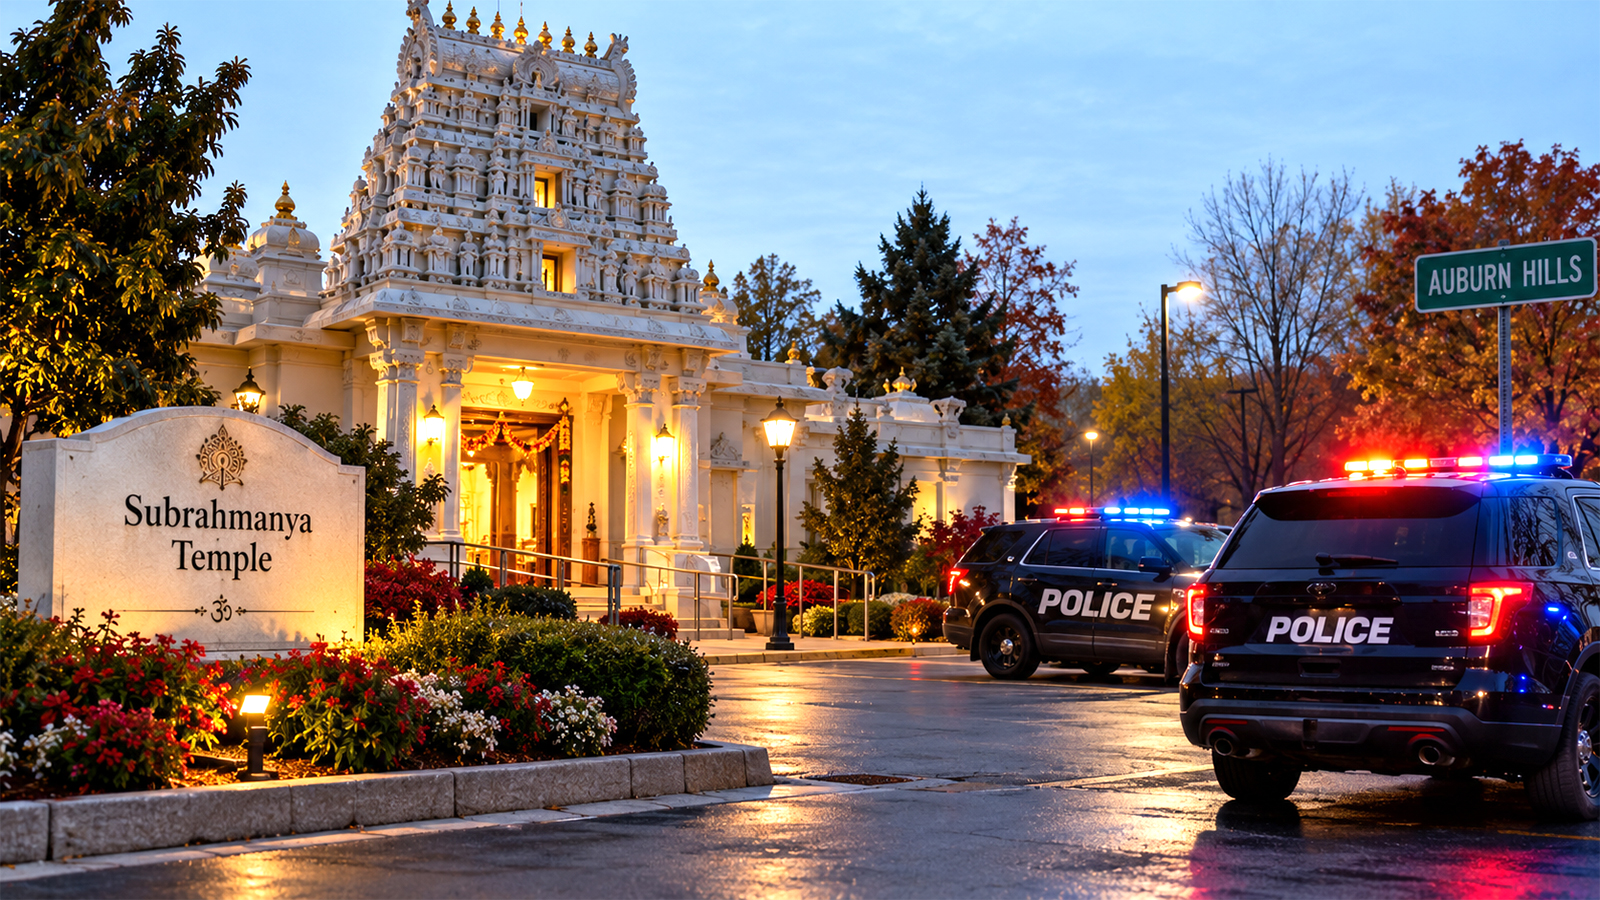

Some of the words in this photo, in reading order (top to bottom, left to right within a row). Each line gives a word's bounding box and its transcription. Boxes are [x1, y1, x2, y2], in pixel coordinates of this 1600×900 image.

[1428, 262, 1511, 296] AUBURN
[1523, 254, 1582, 287] HILLS
[124, 493, 313, 541] Subrahmanya
[171, 539, 273, 581] Temple
[1037, 588, 1156, 621] POLICE
[1265, 616, 1394, 644] POLICE
